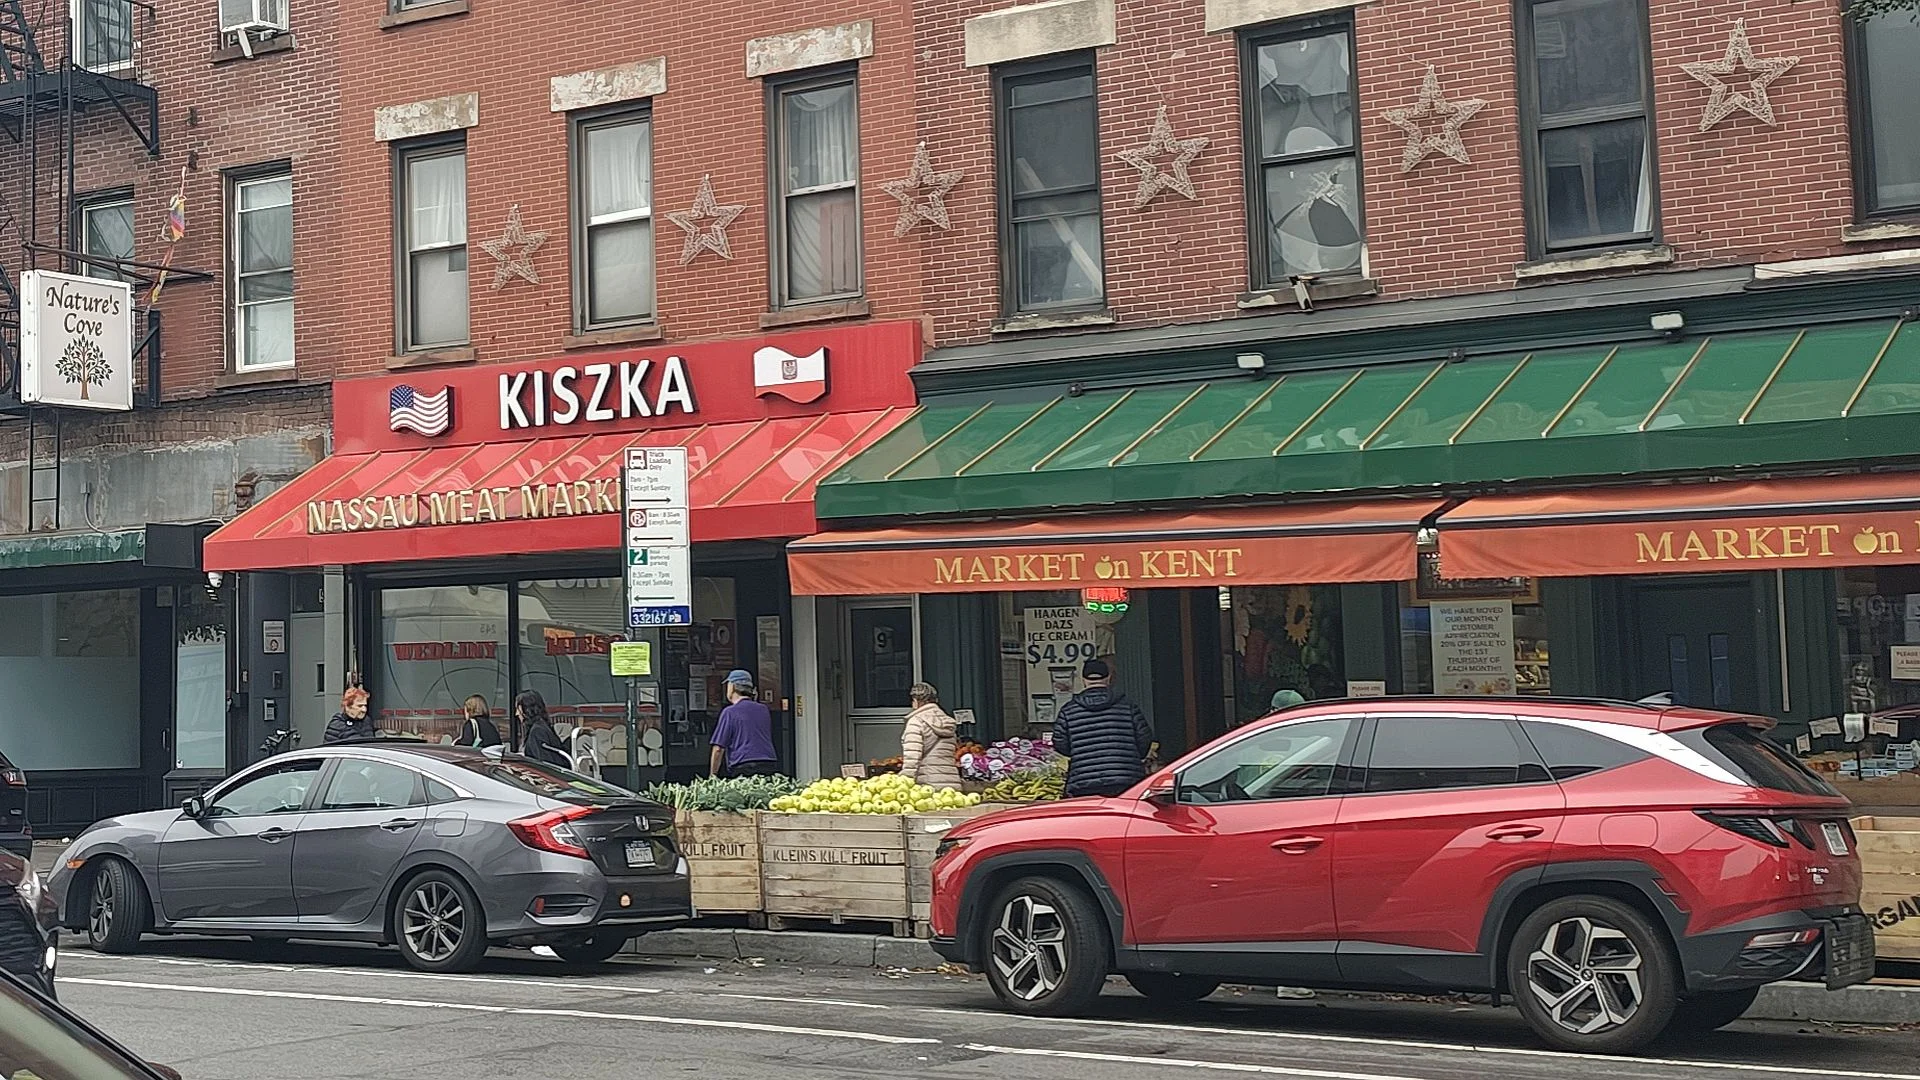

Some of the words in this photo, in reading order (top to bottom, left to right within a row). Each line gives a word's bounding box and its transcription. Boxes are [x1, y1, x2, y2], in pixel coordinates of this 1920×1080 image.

[46, 282, 120, 315] Nature's
[63, 313, 103, 336] Cove
[499, 356, 695, 430] KISZKA
[307, 493, 420, 534] NASSAU
[430, 486, 511, 526] MEAT
[520, 478, 621, 519] MARK
[1635, 524, 1840, 563] MARKET
[633, 549, 644, 564] 2
[934, 552, 1085, 584] MARKET
[1139, 547, 1243, 580] KENT
[632, 579, 652, 587] Except
[653, 579, 673, 587] Sunday
[632, 613, 667, 625] 332167
[1034, 608, 1080, 619] HAAGEN
[1044, 620, 1074, 630] DAZS
[1027, 632, 1045, 642] ICE
[1440, 640, 1456, 648] 20%
[1027, 641, 1096, 668] $4.99
[1448, 656, 1487, 664] THURSDAY
[682, 842, 708, 857] KILL
[711, 843, 746, 857] FRUIT
[773, 848, 818, 863] KLEINS
[819, 849, 848, 863] KILL
[852, 850, 889, 865] FRUIT
